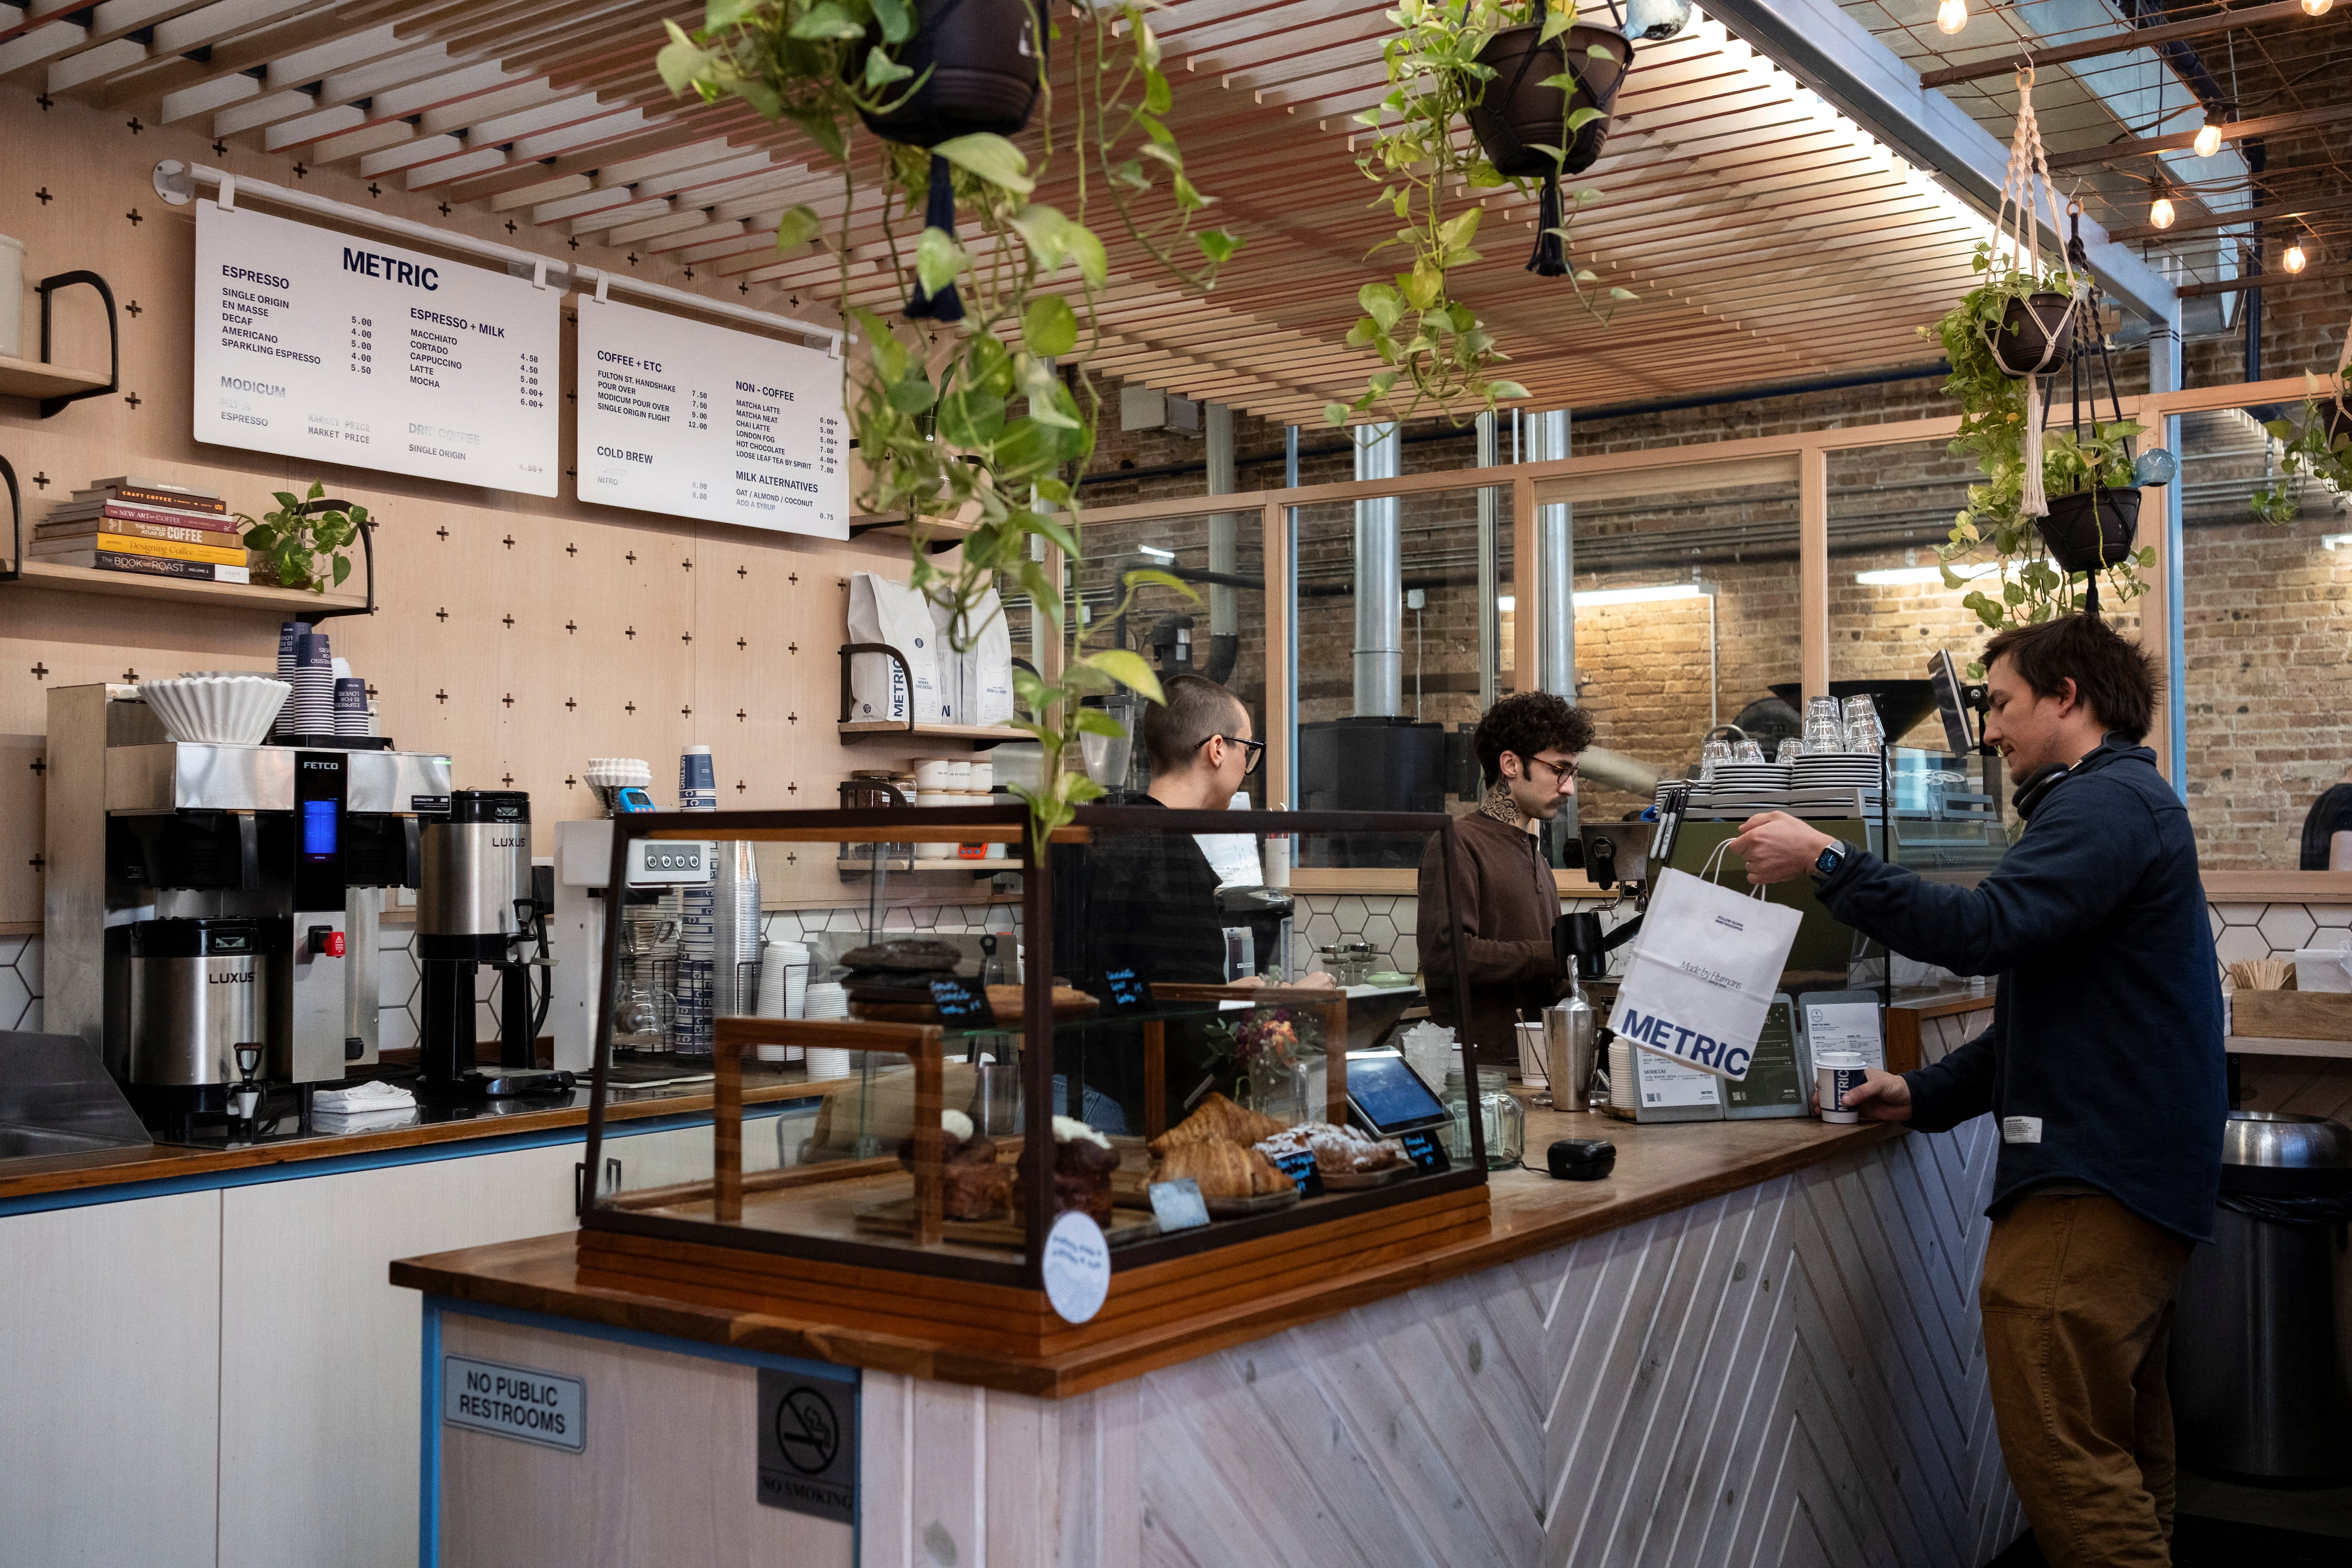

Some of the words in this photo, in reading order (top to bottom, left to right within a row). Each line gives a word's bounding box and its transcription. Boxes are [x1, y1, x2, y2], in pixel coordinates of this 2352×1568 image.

[222, 264, 289, 289] ESPRESSO
[343, 247, 438, 291] METRIC
[222, 287, 255, 302] SINGLE
[257, 294, 289, 309] ORIGIN
[222, 300, 235, 310] EN
[237, 302, 269, 317] MASSE
[222, 312, 253, 326] DECAF
[351, 316, 372, 327] 5.00
[410, 307, 468, 330] ESPRESSO
[479, 323, 505, 338] MILK
[222, 325, 278, 343] AMERICANO
[351, 327, 372, 339] 4.00
[410, 328, 457, 345] MACCHIATO
[221, 337, 273, 355] SPARKLING
[275, 348, 321, 365] ESPRESSO
[351, 339, 372, 350] 5.00
[410, 340, 448, 355] CORTADO
[351, 352, 371, 363] 4.00
[410, 351, 462, 369] CAPPUCCINO
[520, 353, 538, 363] 4.50
[597, 350, 634, 367] COFFEE
[644, 360, 662, 373] ETC
[350, 363, 371, 374] 5.50
[410, 363, 434, 375] LATTE
[520, 364, 538, 374] 4.50
[221, 375, 286, 397] MODICUM
[410, 375, 440, 388] MOCHA
[520, 375, 538, 385] 5.00
[597, 369, 623, 382] FULTON
[624, 375, 634, 384] ST.
[635, 378, 676, 393] HANDSHAKE
[520, 386, 543, 398] 6.00+
[597, 381, 617, 391] POUR
[618, 385, 636, 395] OVER
[691, 390, 707, 399] 7.50
[736, 380, 755, 393] NON
[762, 386, 794, 401] COFFEE
[520, 398, 544, 408] 6.00+
[597, 391, 631, 405] MODICUM
[632, 398, 651, 409] POUR
[652, 402, 669, 412] OVER
[692, 400, 707, 410] 7.50
[736, 399, 762, 410] MATCHA
[763, 405, 780, 414] LATTE
[221, 411, 268, 427] ESPRESSO
[597, 402, 621, 414] SINGLE
[623, 407, 646, 418] ORIGIN
[648, 412, 670, 422] FLIGHT
[691, 411, 707, 420] 9.00
[736, 409, 762, 421] MATCHA
[763, 414, 778, 424] NEAT
[308, 415, 339, 427] MARKET
[344, 420, 370, 432] PRICE
[688, 421, 707, 430] 12.00
[736, 419, 751, 429] CHAI
[752, 422, 770, 432] LATTE
[819, 416, 838, 426] 6.00+
[308, 426, 340, 438] MARKET
[345, 432, 370, 444] PRICE
[736, 430, 762, 441] LONDON
[762, 434, 775, 443] FOG
[820, 426, 834, 435] 5.00
[736, 439, 749, 448] HOT
[749, 442, 785, 455] CHOCOLATE
[820, 436, 838, 446] 5.00+
[408, 444, 437, 455] SINGLE
[438, 448, 466, 461] ORIGIN
[596, 446, 623, 459] COLD
[626, 451, 653, 464] BREW
[819, 446, 834, 454] 7.00
[736, 450, 755, 460] LOOSE
[756, 454, 771, 462] LEAF
[772, 456, 784, 465] TEA
[793, 460, 811, 470] SPIRIT
[819, 456, 838, 465] 4.00+
[820, 464, 834, 474] 7.00
[597, 476, 618, 486] NITRO
[692, 481, 707, 490] 6.00
[736, 470, 757, 482] MILK
[758, 474, 818, 493] ALTERNATIVES
[146, 493, 172, 502] COFFEE
[692, 491, 707, 500] 6.00
[753, 491, 779, 502] ALMOND
[784, 496, 813, 507] COCONUT
[756, 501, 776, 510] SYRUP
[819, 512, 834, 521] 0.75
[167, 526, 202, 542] COFFEE
[129, 541, 167, 554] Designing
[170, 547, 194, 556] Coffee
[114, 557, 143, 568] BOOK
[152, 561, 184, 572] ROAST
[893, 658, 904, 716] METRIC
[493, 838, 525, 847] LUXUS
[209, 972, 256, 984] LUXUS
[1679, 961, 1701, 974] Made
[1700, 967, 1711, 979] by
[1710, 971, 1742, 989] Humans
[1621, 1009, 1750, 1075] METRIC
[467, 1370, 492, 1394] NO
[496, 1376, 559, 1408] PUBLIC
[459, 1394, 566, 1436] RESTROOMS
[761, 1475, 782, 1494] NO
[784, 1482, 853, 1511] SMOKING
